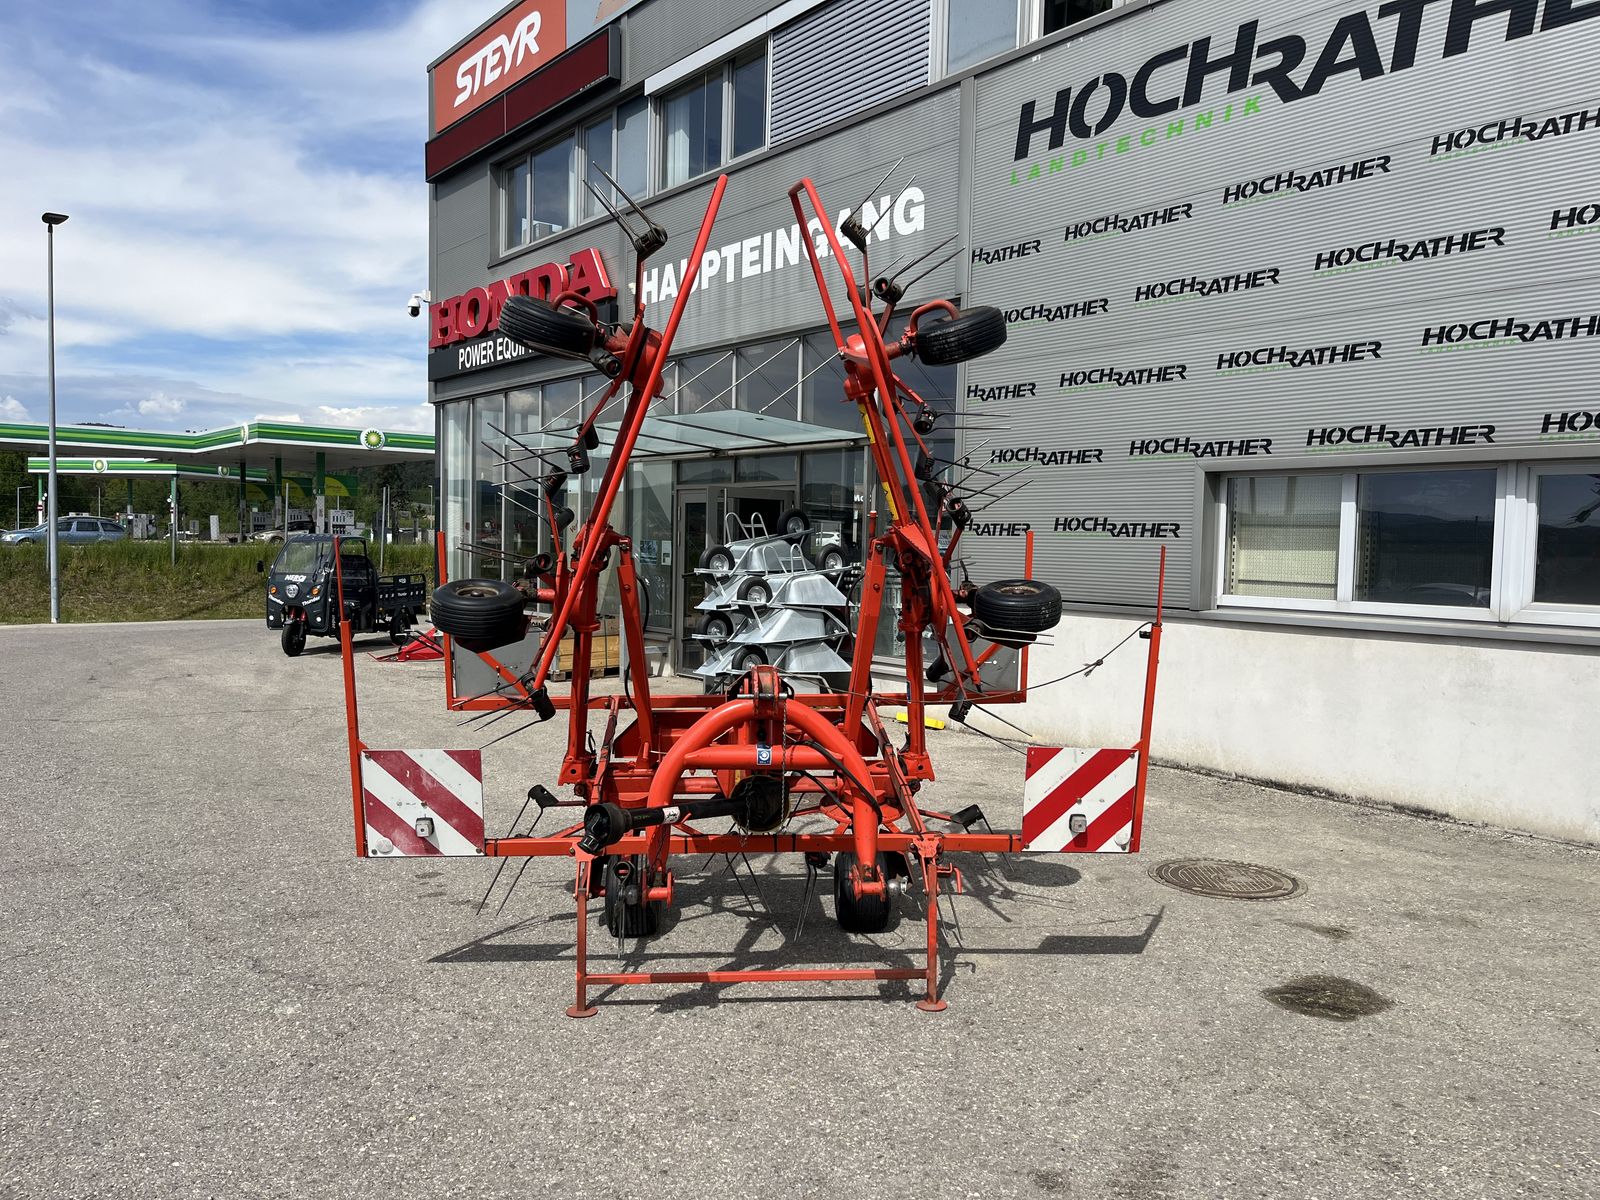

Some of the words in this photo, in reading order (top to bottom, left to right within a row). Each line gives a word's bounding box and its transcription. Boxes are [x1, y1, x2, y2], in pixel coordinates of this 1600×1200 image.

[453, 11, 541, 108] STEYR
[1009, 95, 1262, 185] LANDTECHNIK
[1223, 155, 1390, 204] HOCHRATHER
[1064, 203, 1193, 241] HOCHRATHER
[1314, 227, 1506, 270] HOCHRATHER
[429, 247, 617, 348] HONDA
[1135, 268, 1279, 301] HOCHRATHER
[1422, 315, 1600, 347] HOCHRATH
[458, 340, 494, 370] POWER
[1216, 341, 1382, 369] HOCHRATHER
[1059, 365, 1187, 387] HOCHRATHER
[1129, 437, 1272, 458] HOCHRATHER
[1306, 424, 1495, 448] HOCHRATHER
[990, 447, 1103, 466] HOCHRATHER
[1053, 517, 1180, 538] HOCHRATHER
